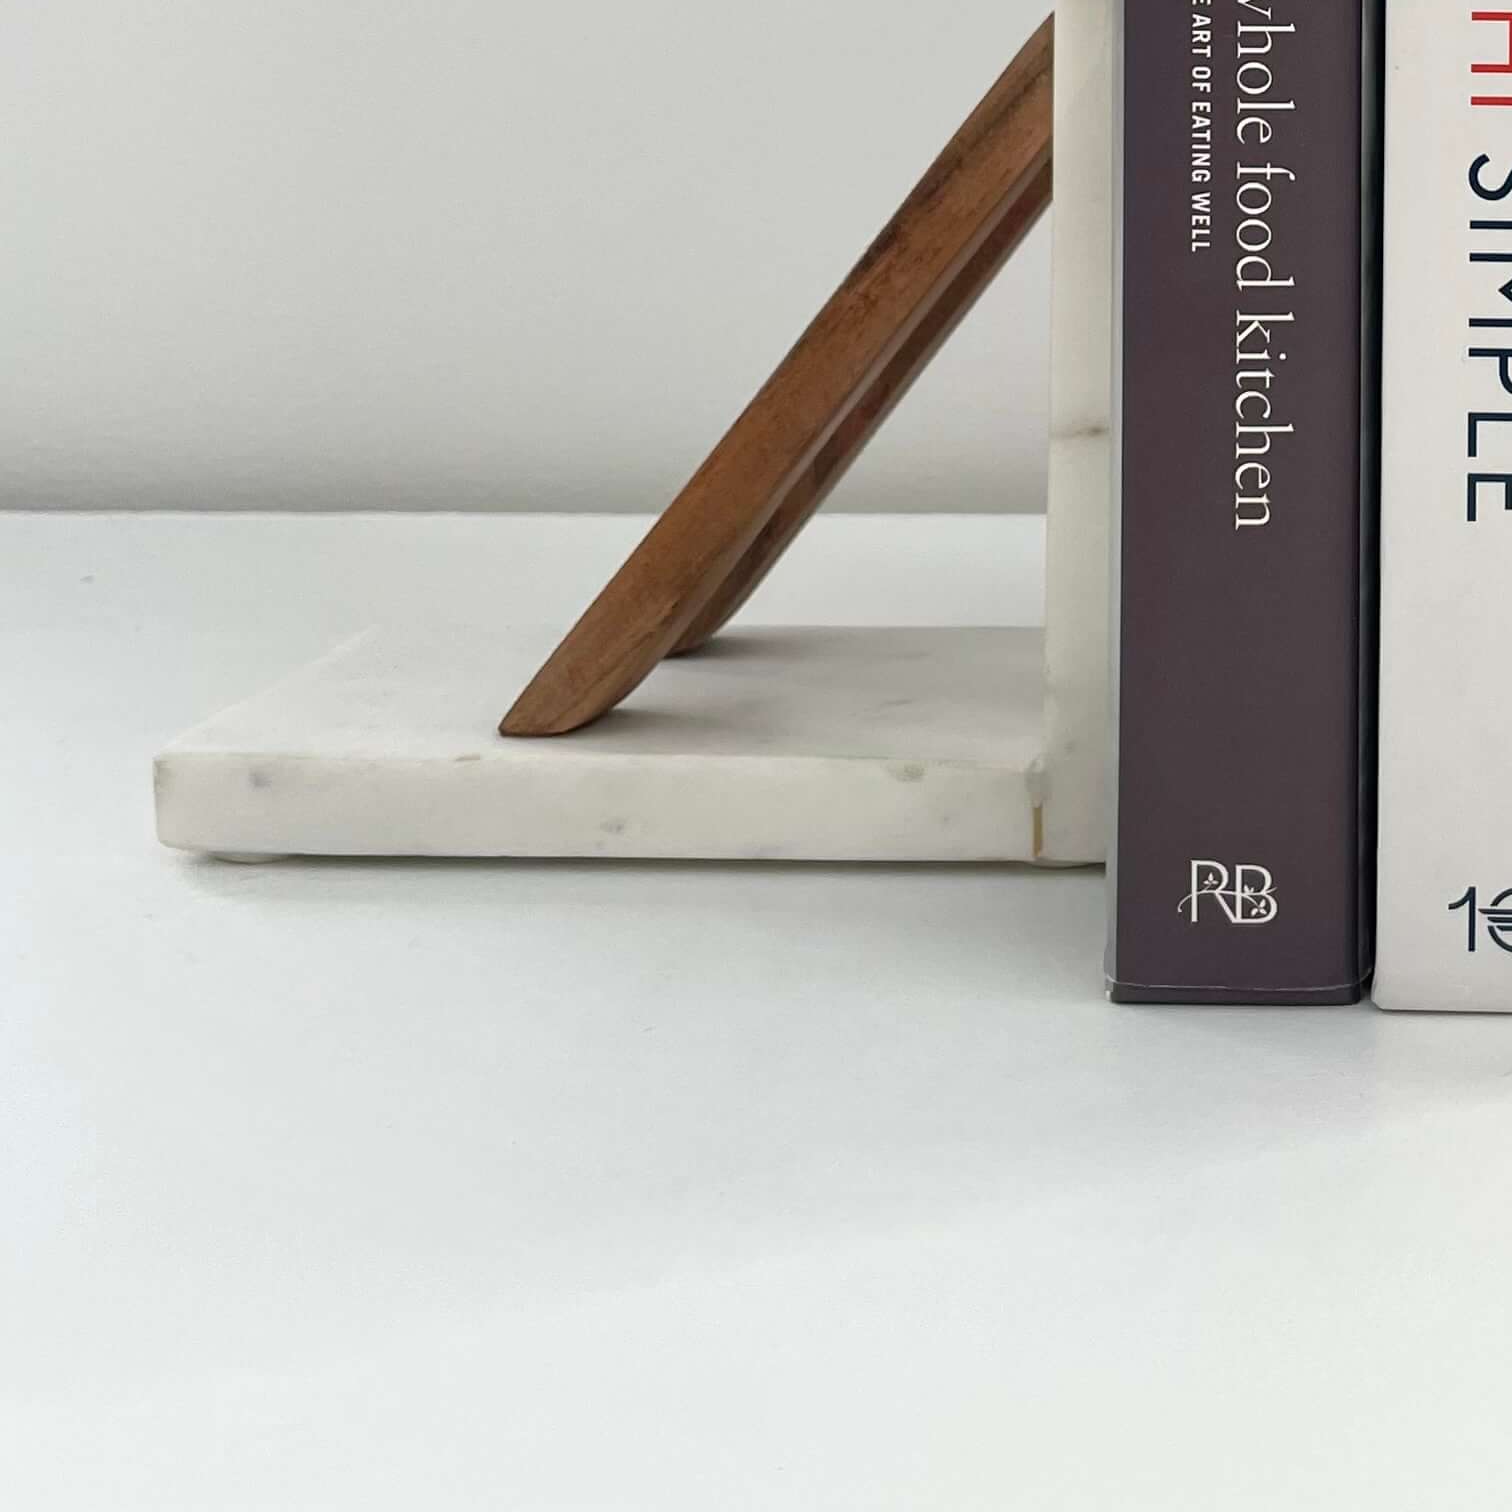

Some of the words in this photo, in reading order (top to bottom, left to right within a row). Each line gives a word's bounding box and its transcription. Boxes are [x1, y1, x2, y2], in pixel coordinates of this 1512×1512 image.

[1191, 13, 1212, 58] ART
[1191, 66, 1212, 93] OF
[1191, 101, 1212, 183] EATING
[1190, 191, 1211, 253] WELL
[1235, 161, 1296, 291] food
[1234, 309, 1295, 531] kitchen
